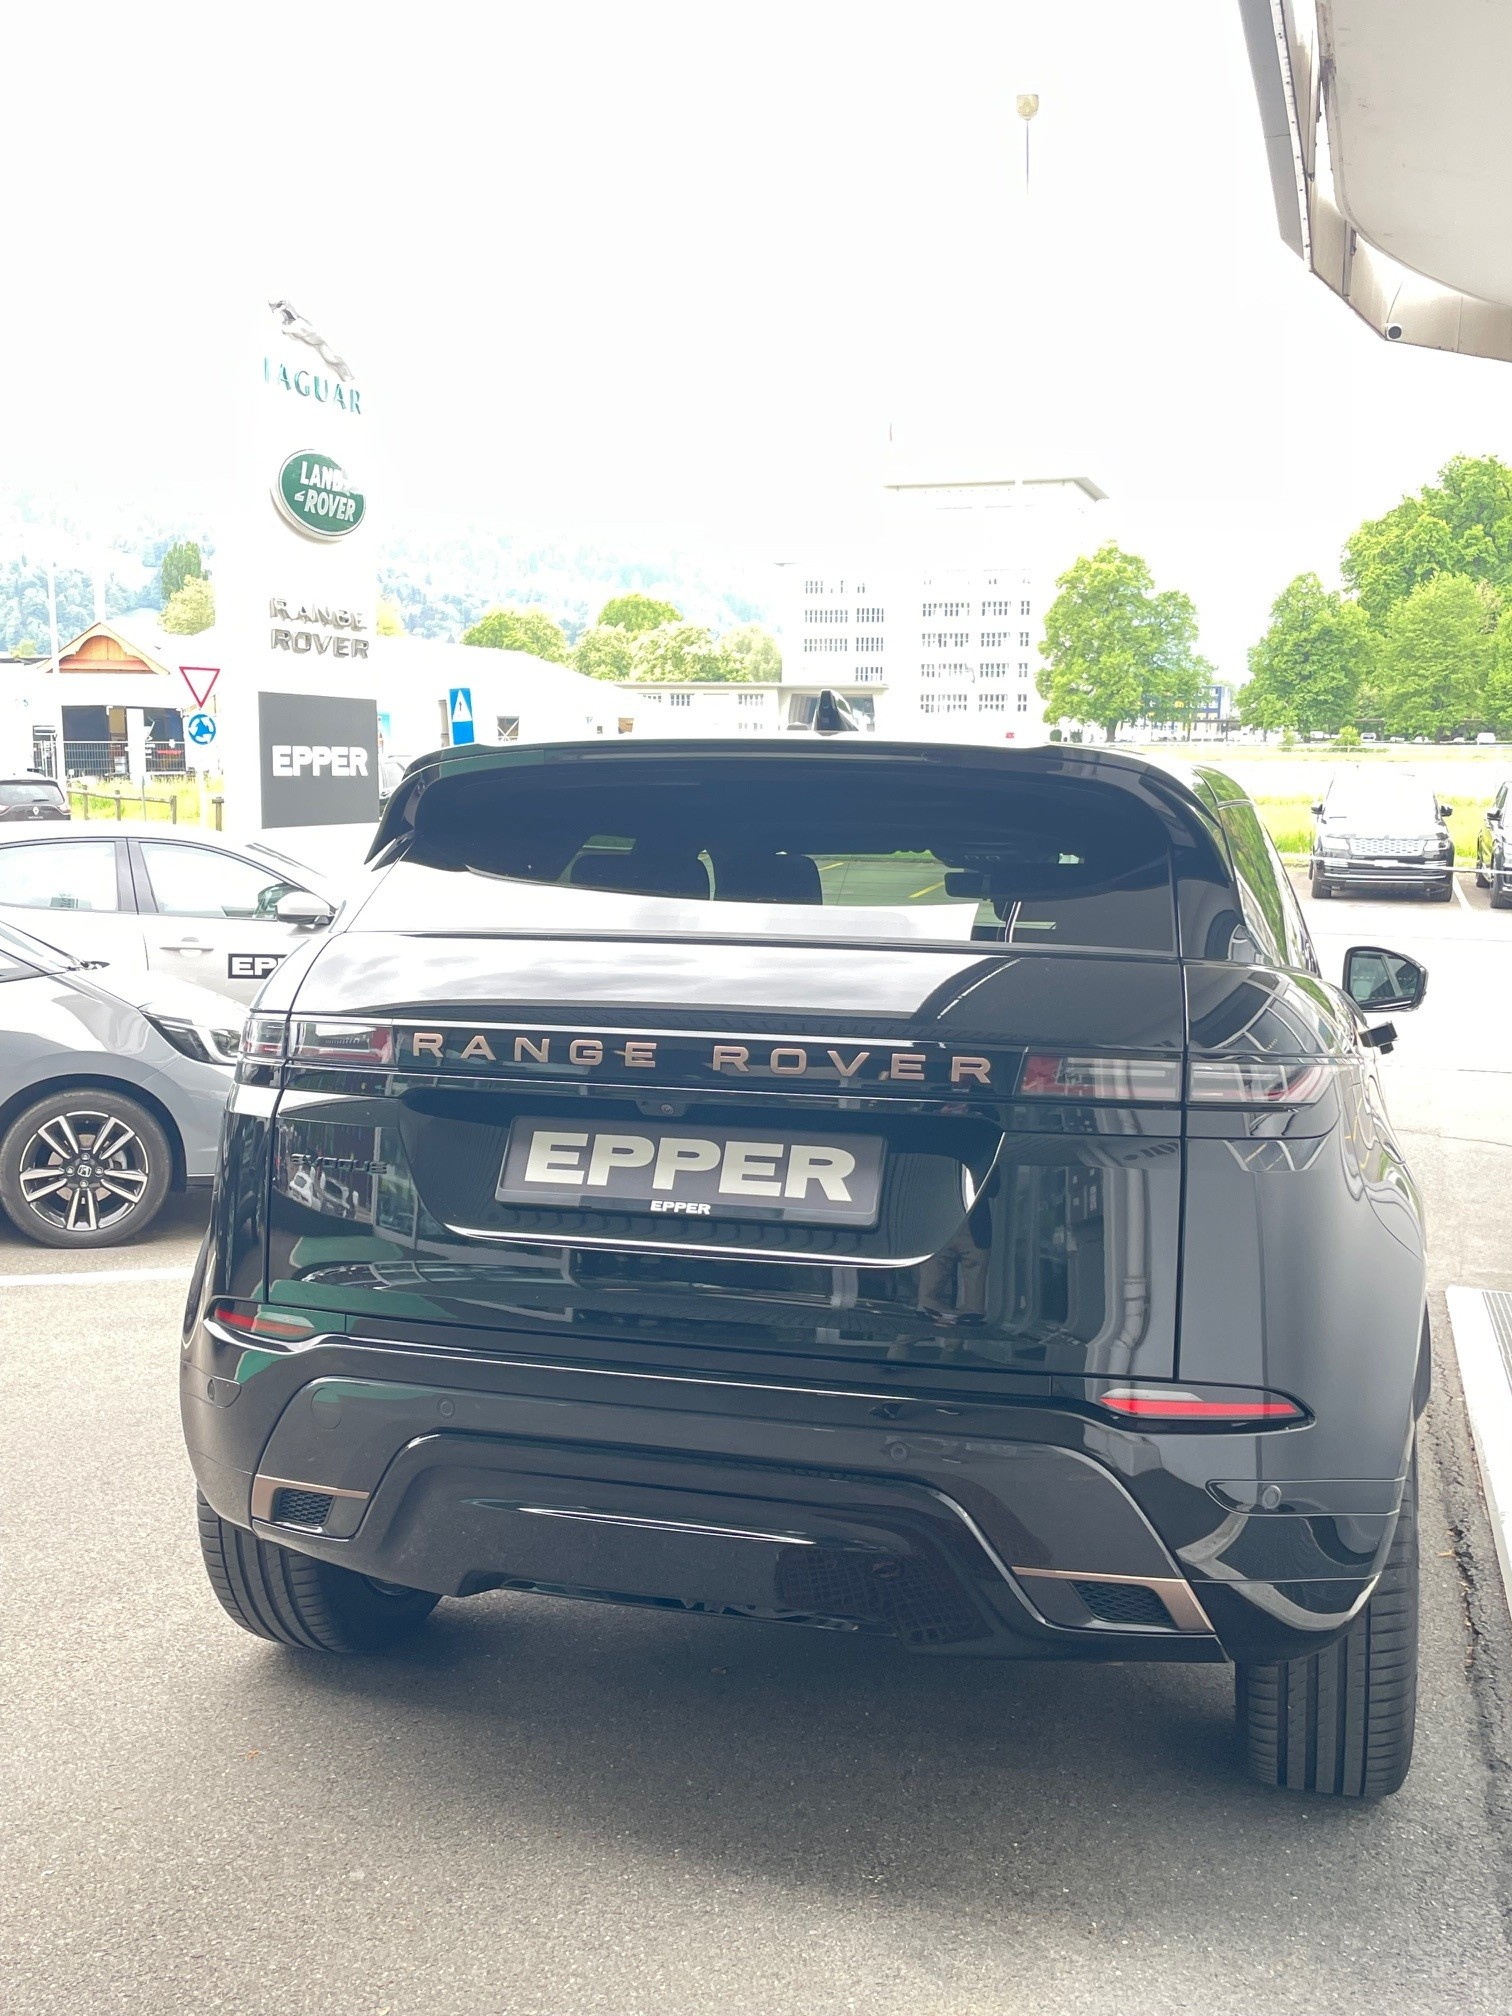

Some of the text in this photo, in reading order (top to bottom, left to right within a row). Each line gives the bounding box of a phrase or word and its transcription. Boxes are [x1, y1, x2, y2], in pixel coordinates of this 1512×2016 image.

[263, 356, 362, 415] JAGUAR
[304, 489, 356, 522] ROVER
[270, 628, 370, 659] ROVER
[272, 745, 368, 777] EPPER
[411, 1032, 992, 1084] RANGE ROVER
[523, 1130, 856, 1202] EPPER
[650, 1200, 711, 1215] EPPER
